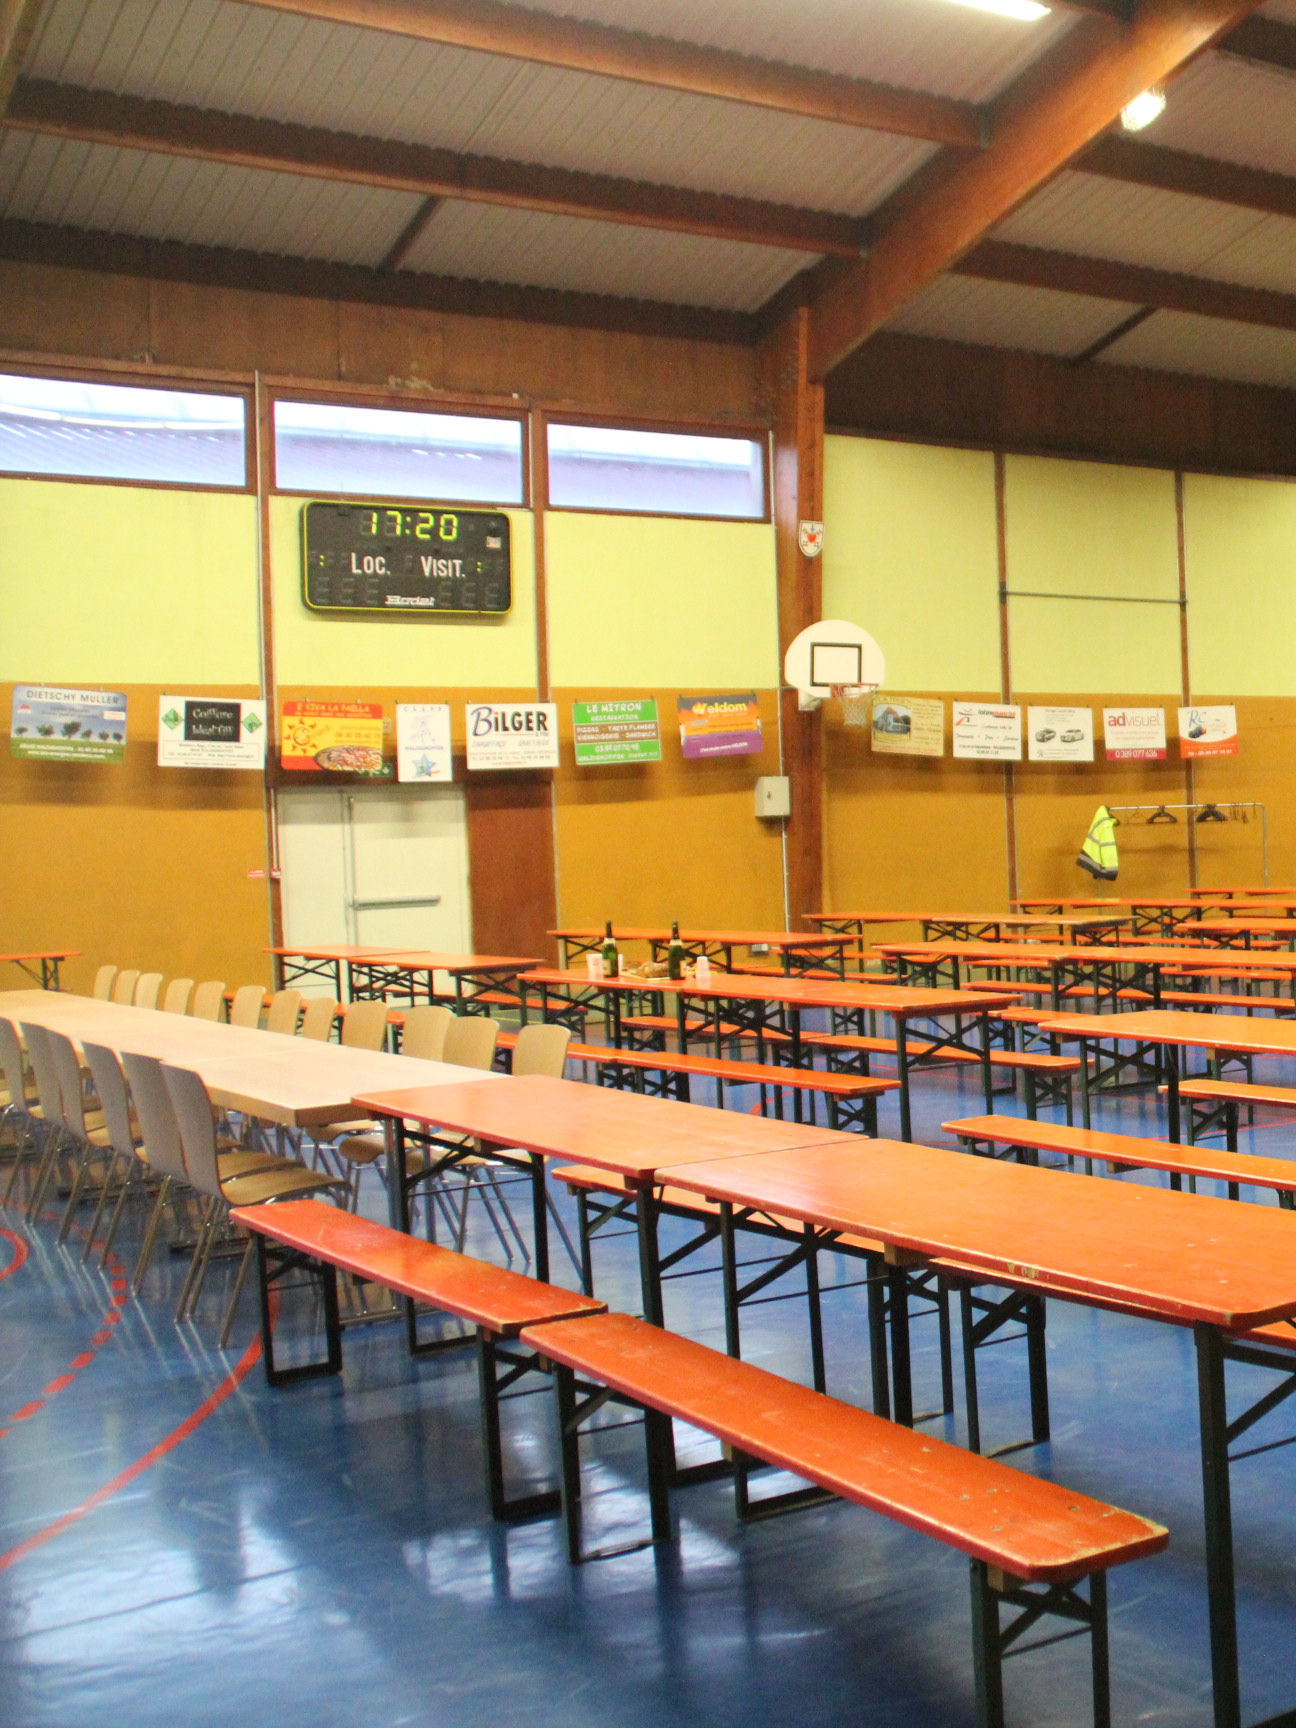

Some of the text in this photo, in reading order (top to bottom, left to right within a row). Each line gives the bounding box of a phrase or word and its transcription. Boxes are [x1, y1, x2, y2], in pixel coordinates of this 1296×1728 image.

[370, 510, 459, 541] 17:20
[385, 595, 436, 607] Bodet
[26, 690, 119, 704] DIETSCHY MULLER
[192, 708, 234, 719] Coiffure
[305, 703, 326, 712] VIVA
[328, 704, 339, 712] LA
[341, 704, 370, 713] PAELLA
[586, 702, 642, 713] LE MITRON
[692, 702, 748, 715] Weldom
[1107, 712, 1161, 727] advisuel
